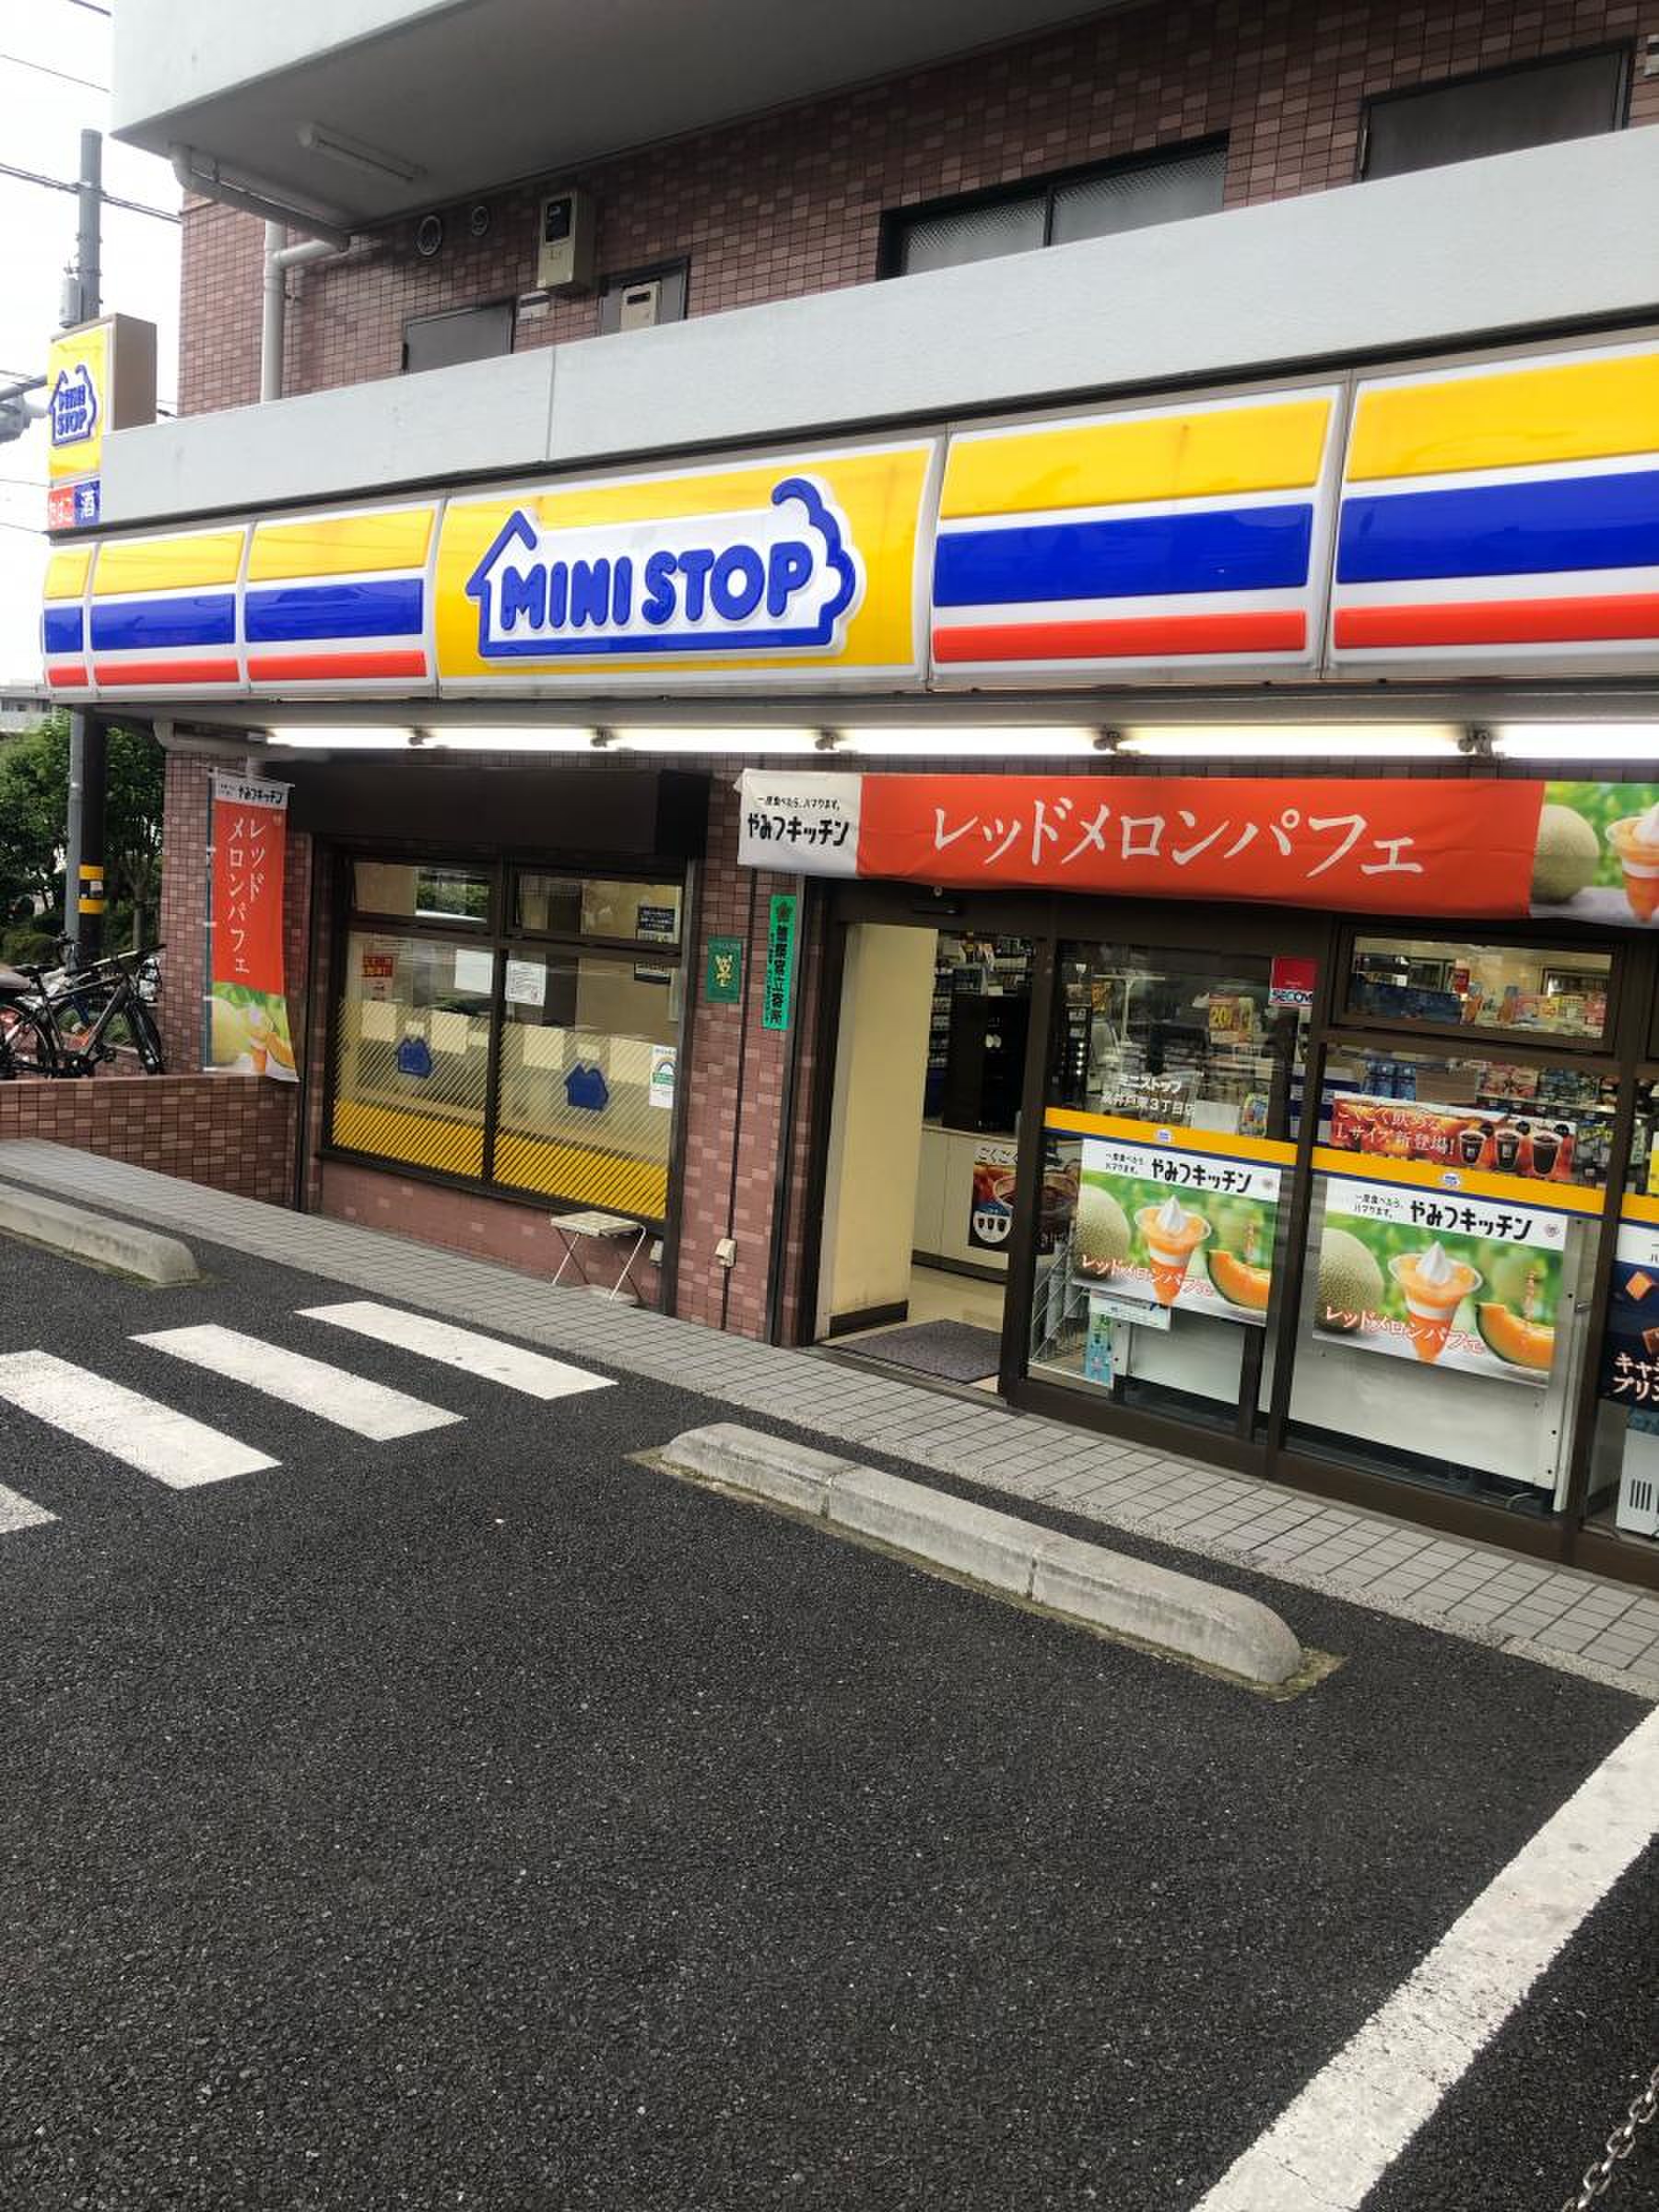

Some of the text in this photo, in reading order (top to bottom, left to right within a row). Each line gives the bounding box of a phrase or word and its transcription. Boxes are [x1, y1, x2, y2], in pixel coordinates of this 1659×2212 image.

[57, 408, 87, 436] STOP
[500, 540, 814, 631] MINI STOP
[747, 812, 850, 846] やみつキッチン
[933, 796, 1425, 878] レッドメロンパフェ
[250, 820, 266, 903] レッド
[227, 817, 251, 974] メロンパフェ
[1119, 1073, 1182, 1094] ミニストップ
[1151, 1158, 1253, 1194] やみつキッチン
[1410, 1199, 1533, 1241] やみつキッチン
[1325, 1305, 1486, 1355] レッドメロンパフェ
